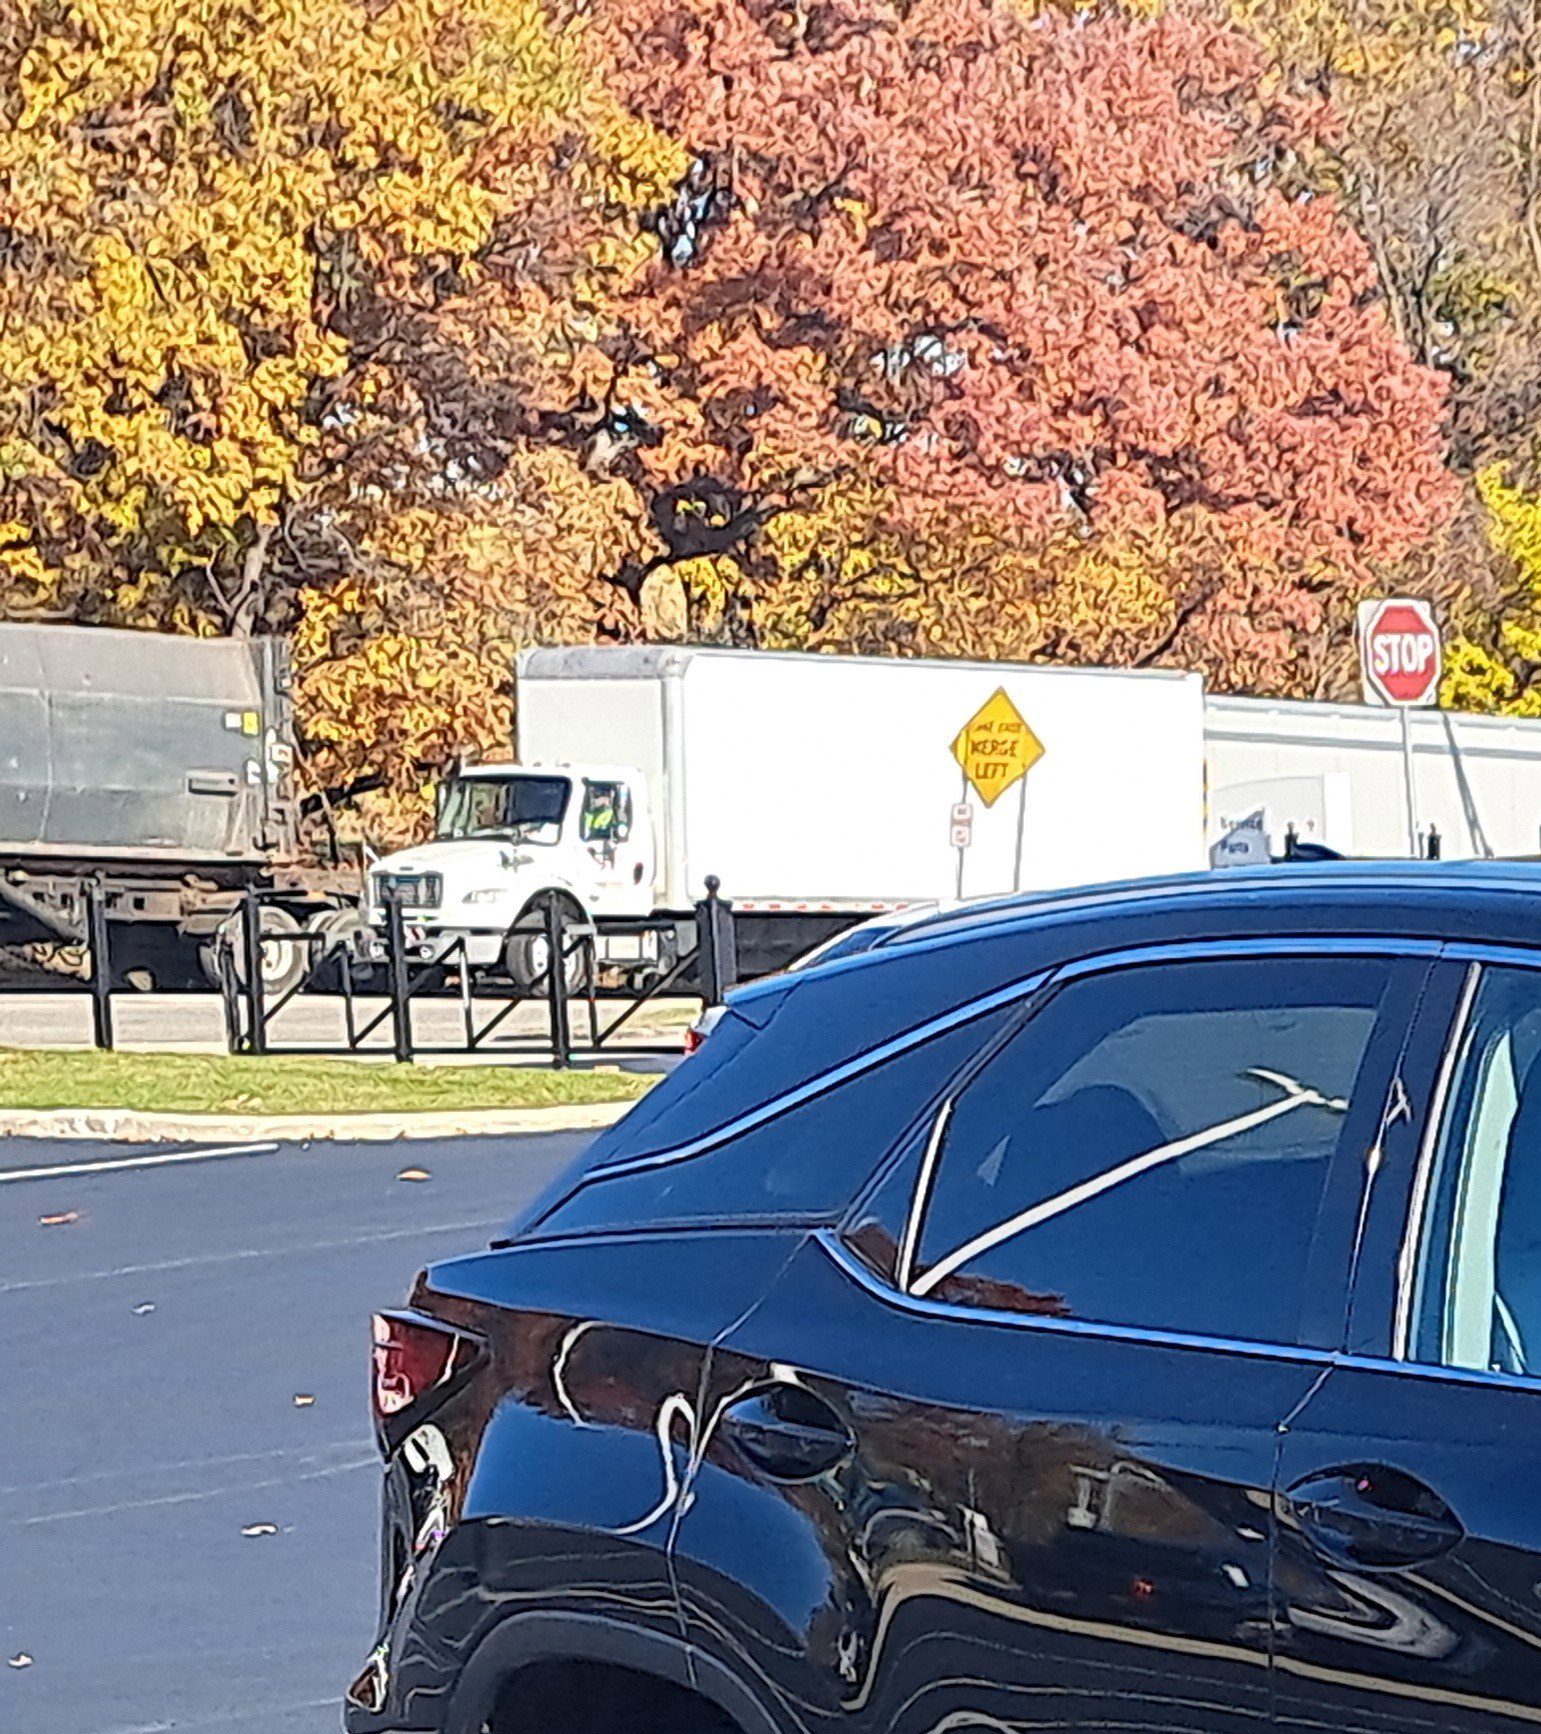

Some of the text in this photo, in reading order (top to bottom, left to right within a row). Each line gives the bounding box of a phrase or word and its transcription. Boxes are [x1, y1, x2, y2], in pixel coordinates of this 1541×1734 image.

[1373, 633, 1434, 675] STOP
[970, 738, 1019, 758] MERGE
[974, 762, 1009, 779] LEFT
